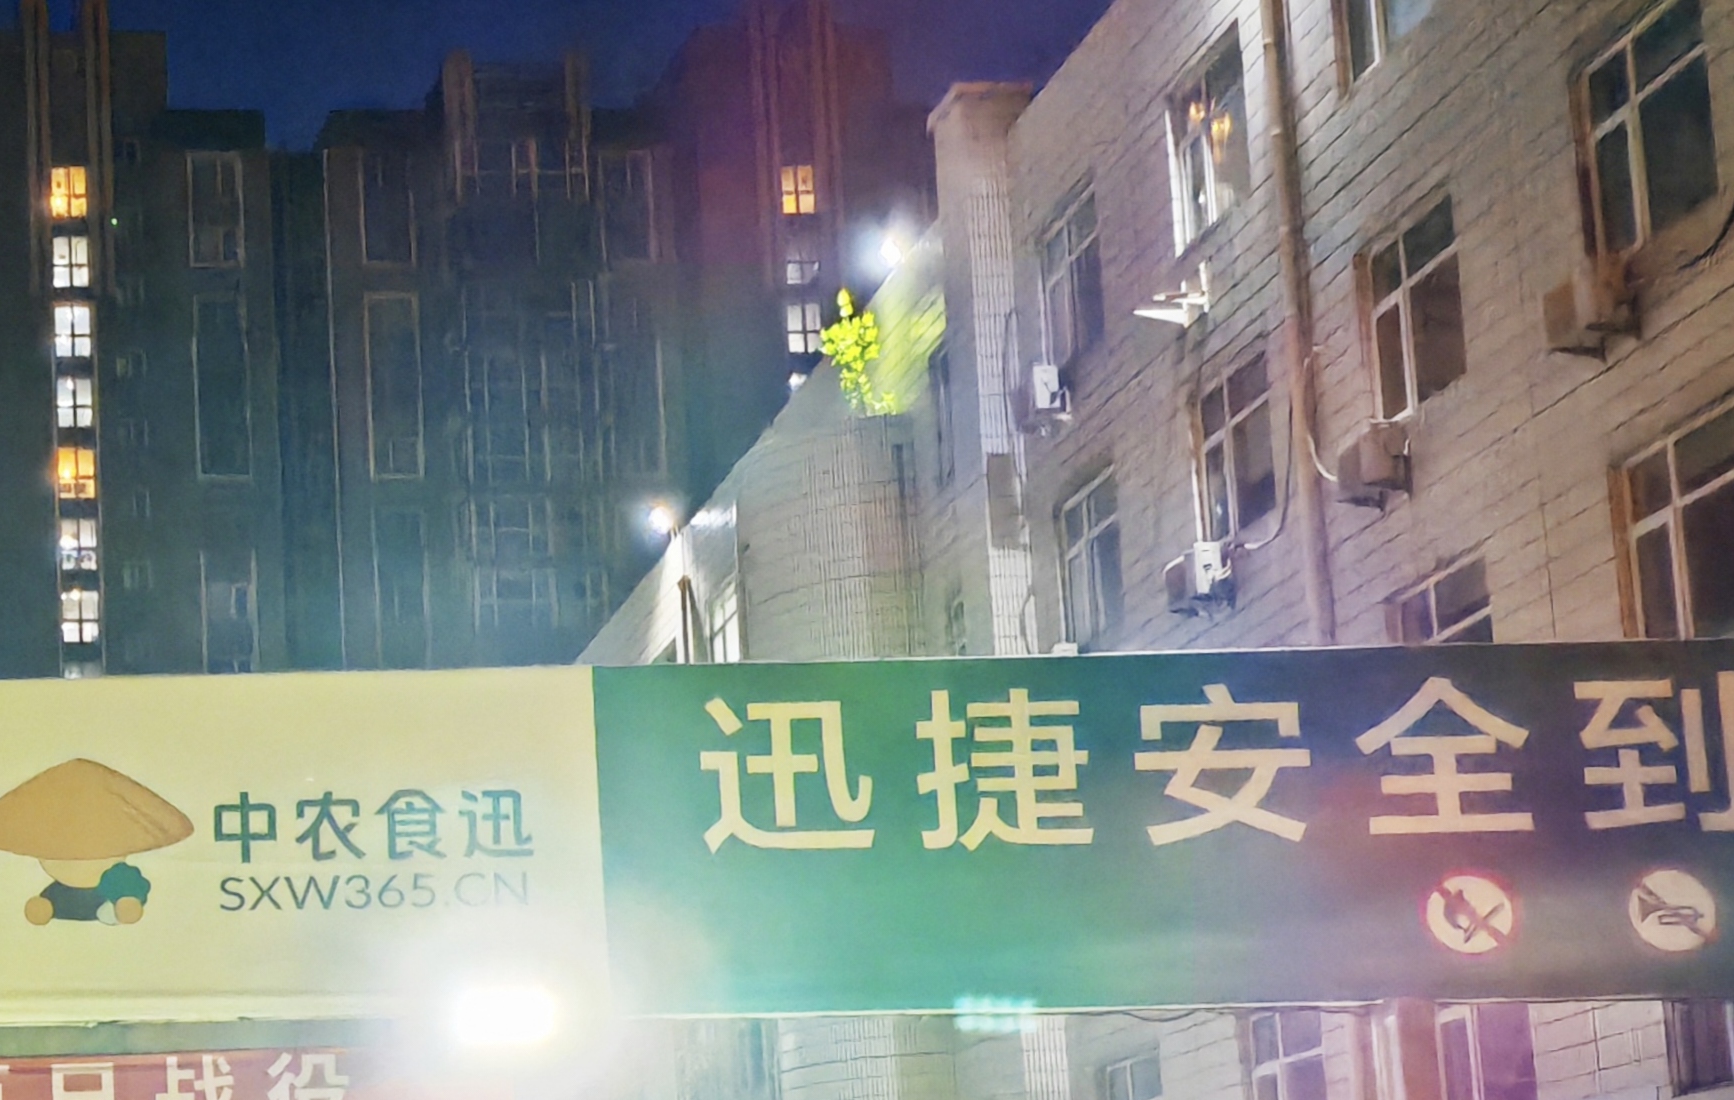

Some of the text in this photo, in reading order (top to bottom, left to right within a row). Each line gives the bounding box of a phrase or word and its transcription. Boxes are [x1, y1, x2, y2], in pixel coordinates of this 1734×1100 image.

[699, 671, 1734, 853] 迅捷安全到
[214, 789, 534, 863] 中农食迅
[219, 872, 529, 911] SXW365.CN
